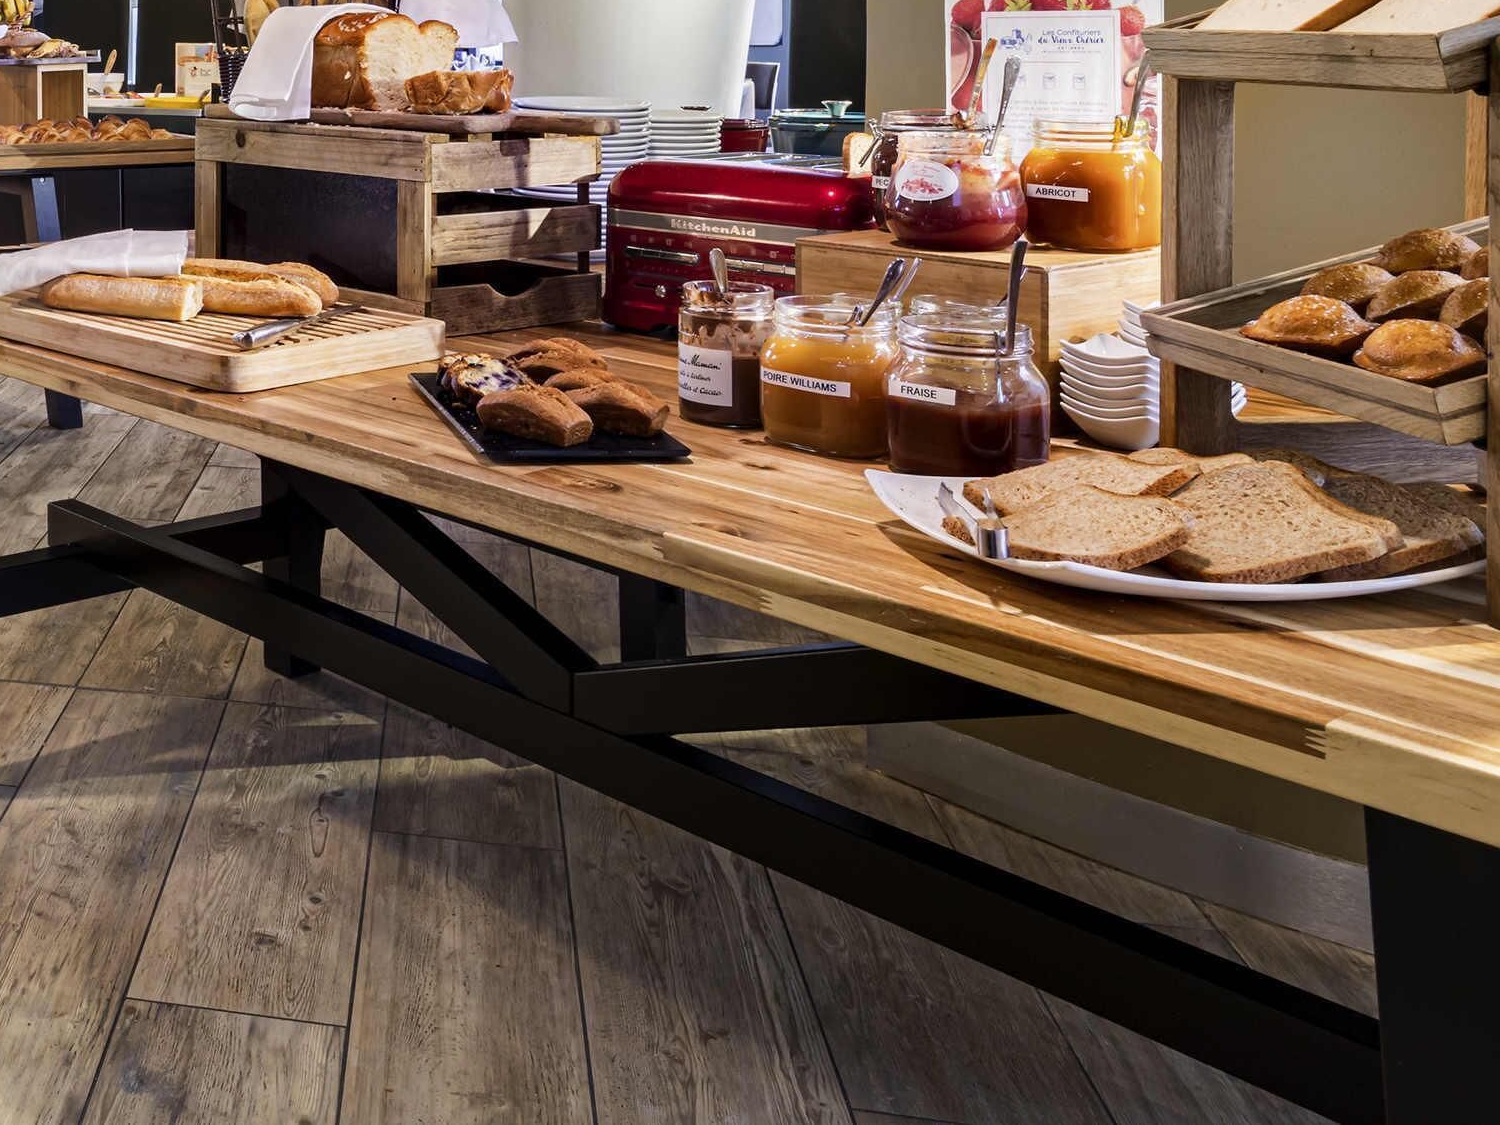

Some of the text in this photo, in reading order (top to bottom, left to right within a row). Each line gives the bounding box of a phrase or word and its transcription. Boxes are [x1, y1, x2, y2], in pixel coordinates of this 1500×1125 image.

[1035, 187, 1076, 198] ABRICOT
[670, 218, 756, 237] KitchenAid
[763, 370, 837, 393] POIRE WILLIAMS
[900, 385, 937, 399] FRAISE
